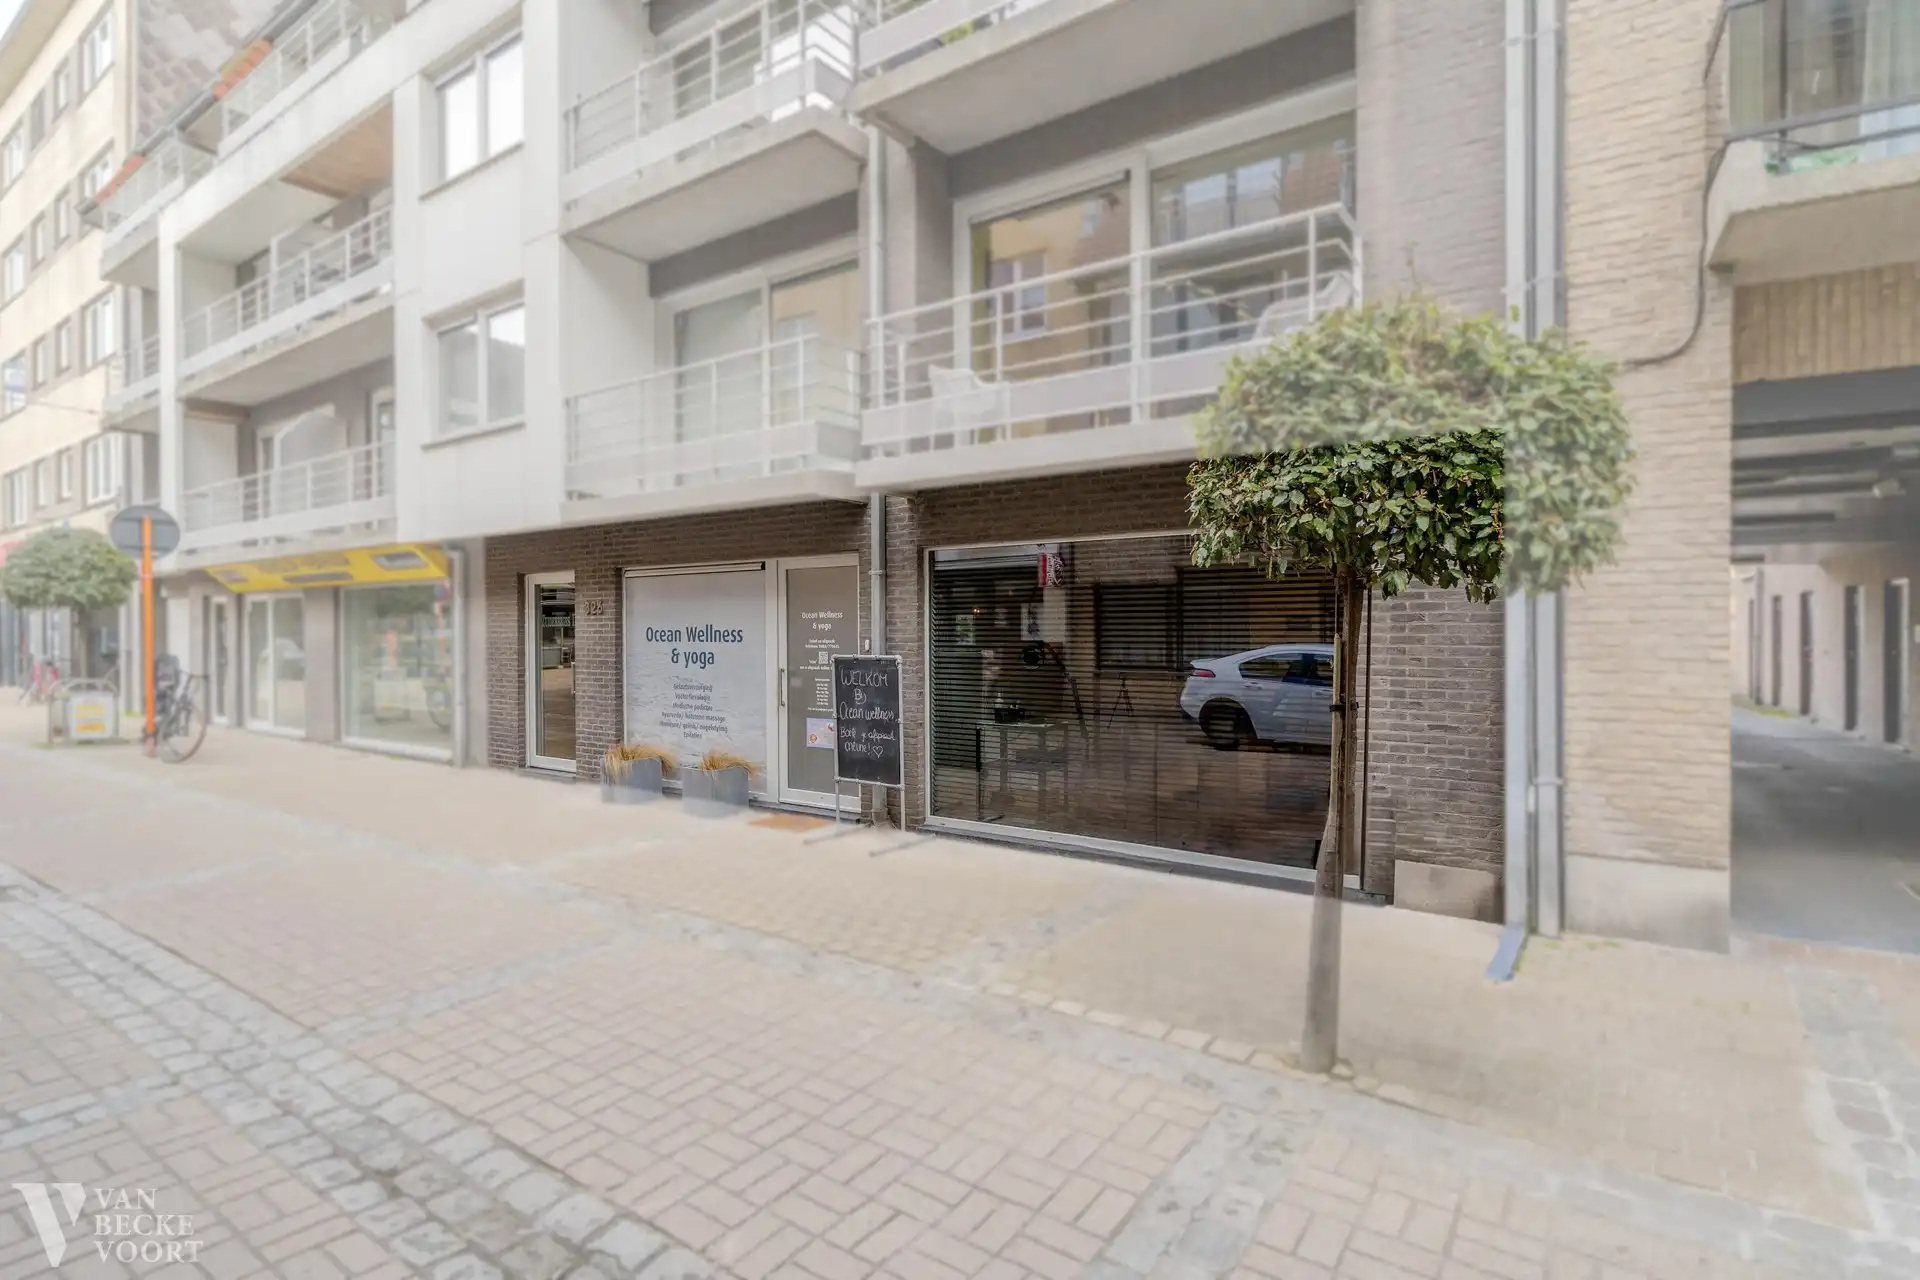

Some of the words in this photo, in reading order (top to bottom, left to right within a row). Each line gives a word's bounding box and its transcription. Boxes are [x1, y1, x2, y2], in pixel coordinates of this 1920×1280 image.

[801, 611, 818, 619] Ocean
[818, 610, 843, 619] Wellness
[645, 626, 682, 643] Ocean
[685, 624, 744, 643] Wellness
[812, 622, 818, 630] &
[818, 623, 832, 631] yoga
[671, 647, 680, 664] &
[683, 651, 715, 670] yoga
[841, 668, 888, 687] WELKOM
[840, 701, 864, 720] Ocean
